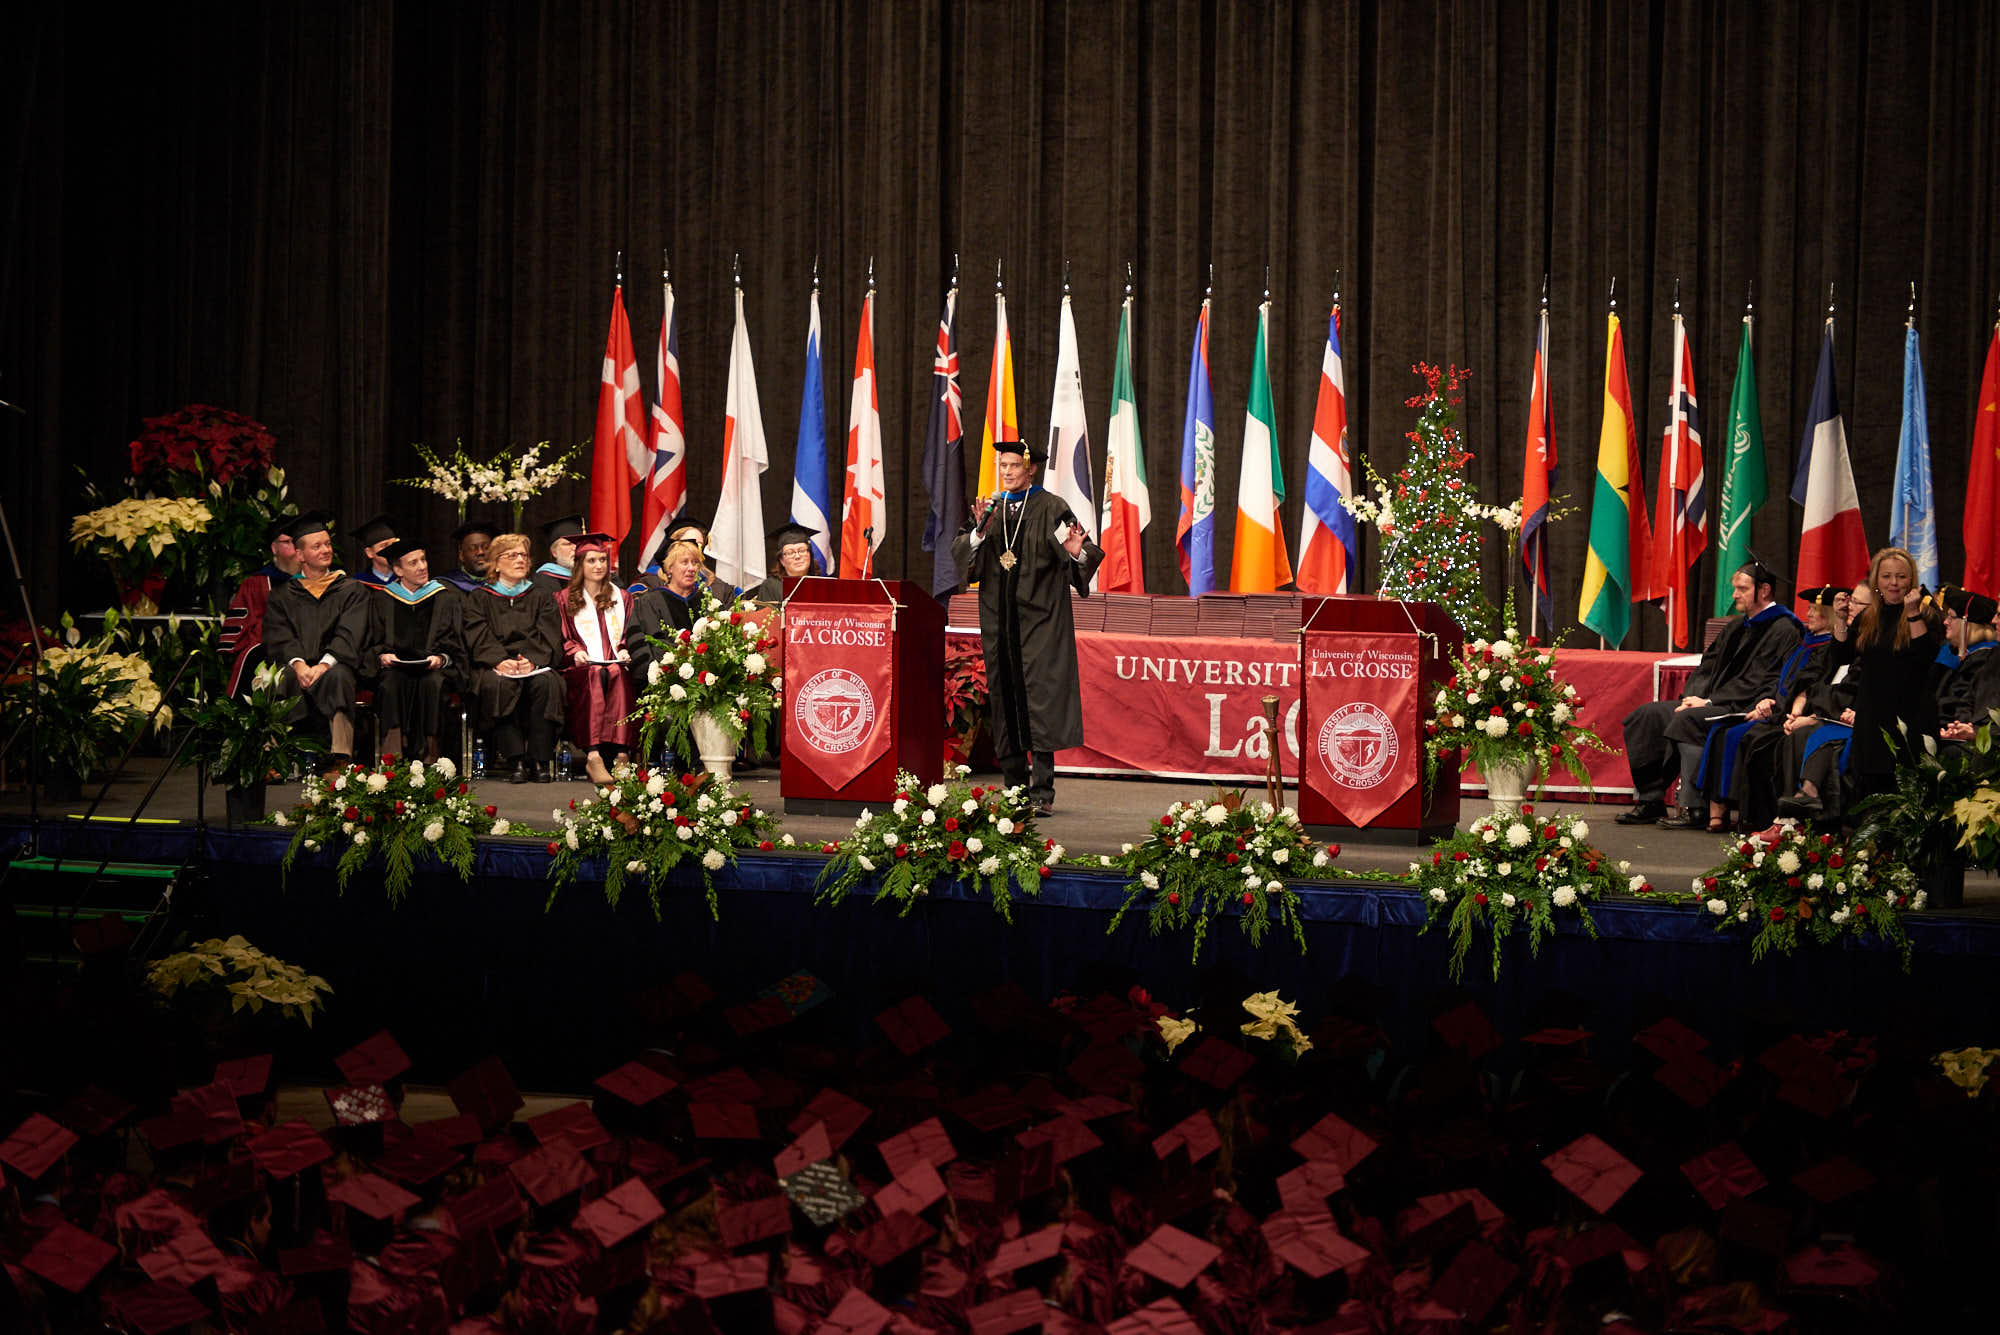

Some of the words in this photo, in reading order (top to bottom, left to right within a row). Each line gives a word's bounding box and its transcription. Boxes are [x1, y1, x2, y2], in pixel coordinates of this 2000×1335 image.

[791, 616, 833, 628] University
[833, 617, 843, 628] of
[844, 617, 886, 628] Wisconsin
[790, 629, 814, 644] LA
[817, 630, 886, 647] CROSSE
[1312, 649, 1356, 661] University
[1356, 649, 1366, 661] of
[1367, 650, 1413, 661] Wisconsin
[1115, 656, 1301, 687] UNIVERSIT
[1311, 661, 1336, 677] LA
[1340, 662, 1412, 679] CROSSE
[798, 672, 827, 720] UNIVERSITY
[831, 670, 842, 679] OF
[849, 674, 873, 722] WISCONSIN
[1321, 707, 1349, 755] UNIVERSITY
[1353, 704, 1367, 713] OF
[1372, 708, 1398, 757] WISCONSIN
[808, 735, 820, 747] LA
[823, 737, 861, 752] CROSSE
[1332, 771, 1344, 784] LA
[1348, 773, 1384, 787] CROSSE
